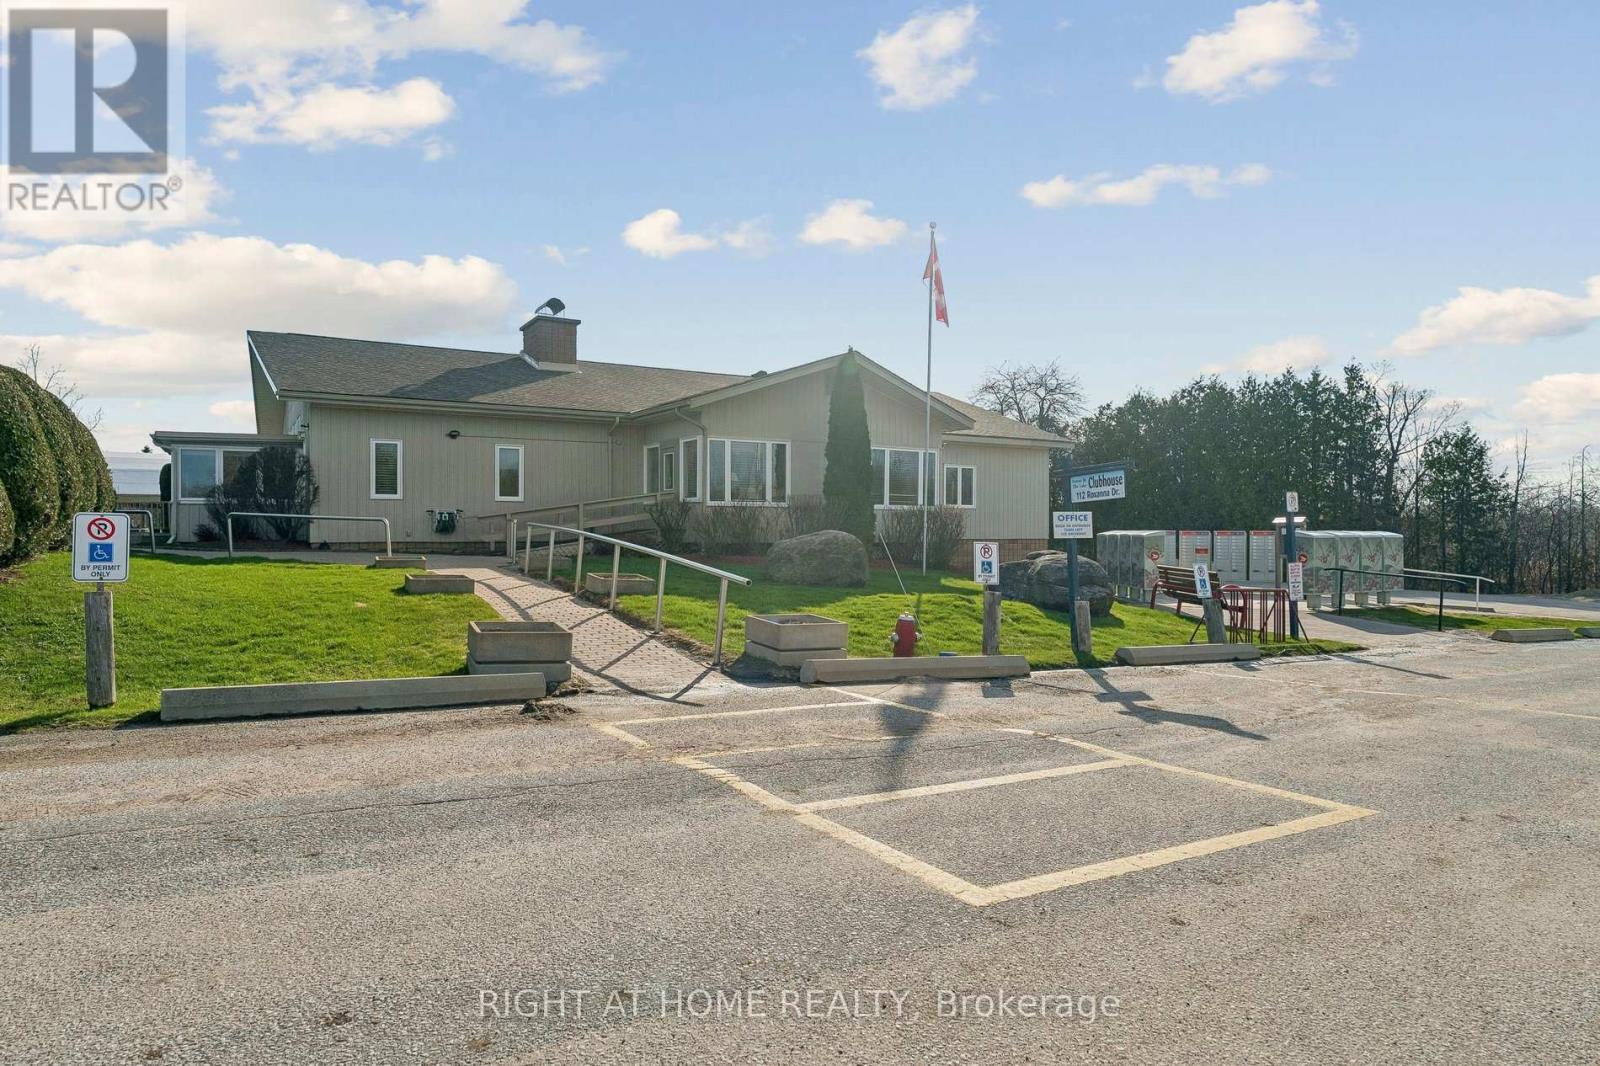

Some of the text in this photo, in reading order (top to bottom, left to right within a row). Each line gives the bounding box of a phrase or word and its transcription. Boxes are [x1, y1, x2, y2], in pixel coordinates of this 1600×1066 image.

[1088, 474, 1123, 489] Clubhouse
[1076, 491, 1086, 500] 112
[1057, 514, 1089, 522] OFFICE
